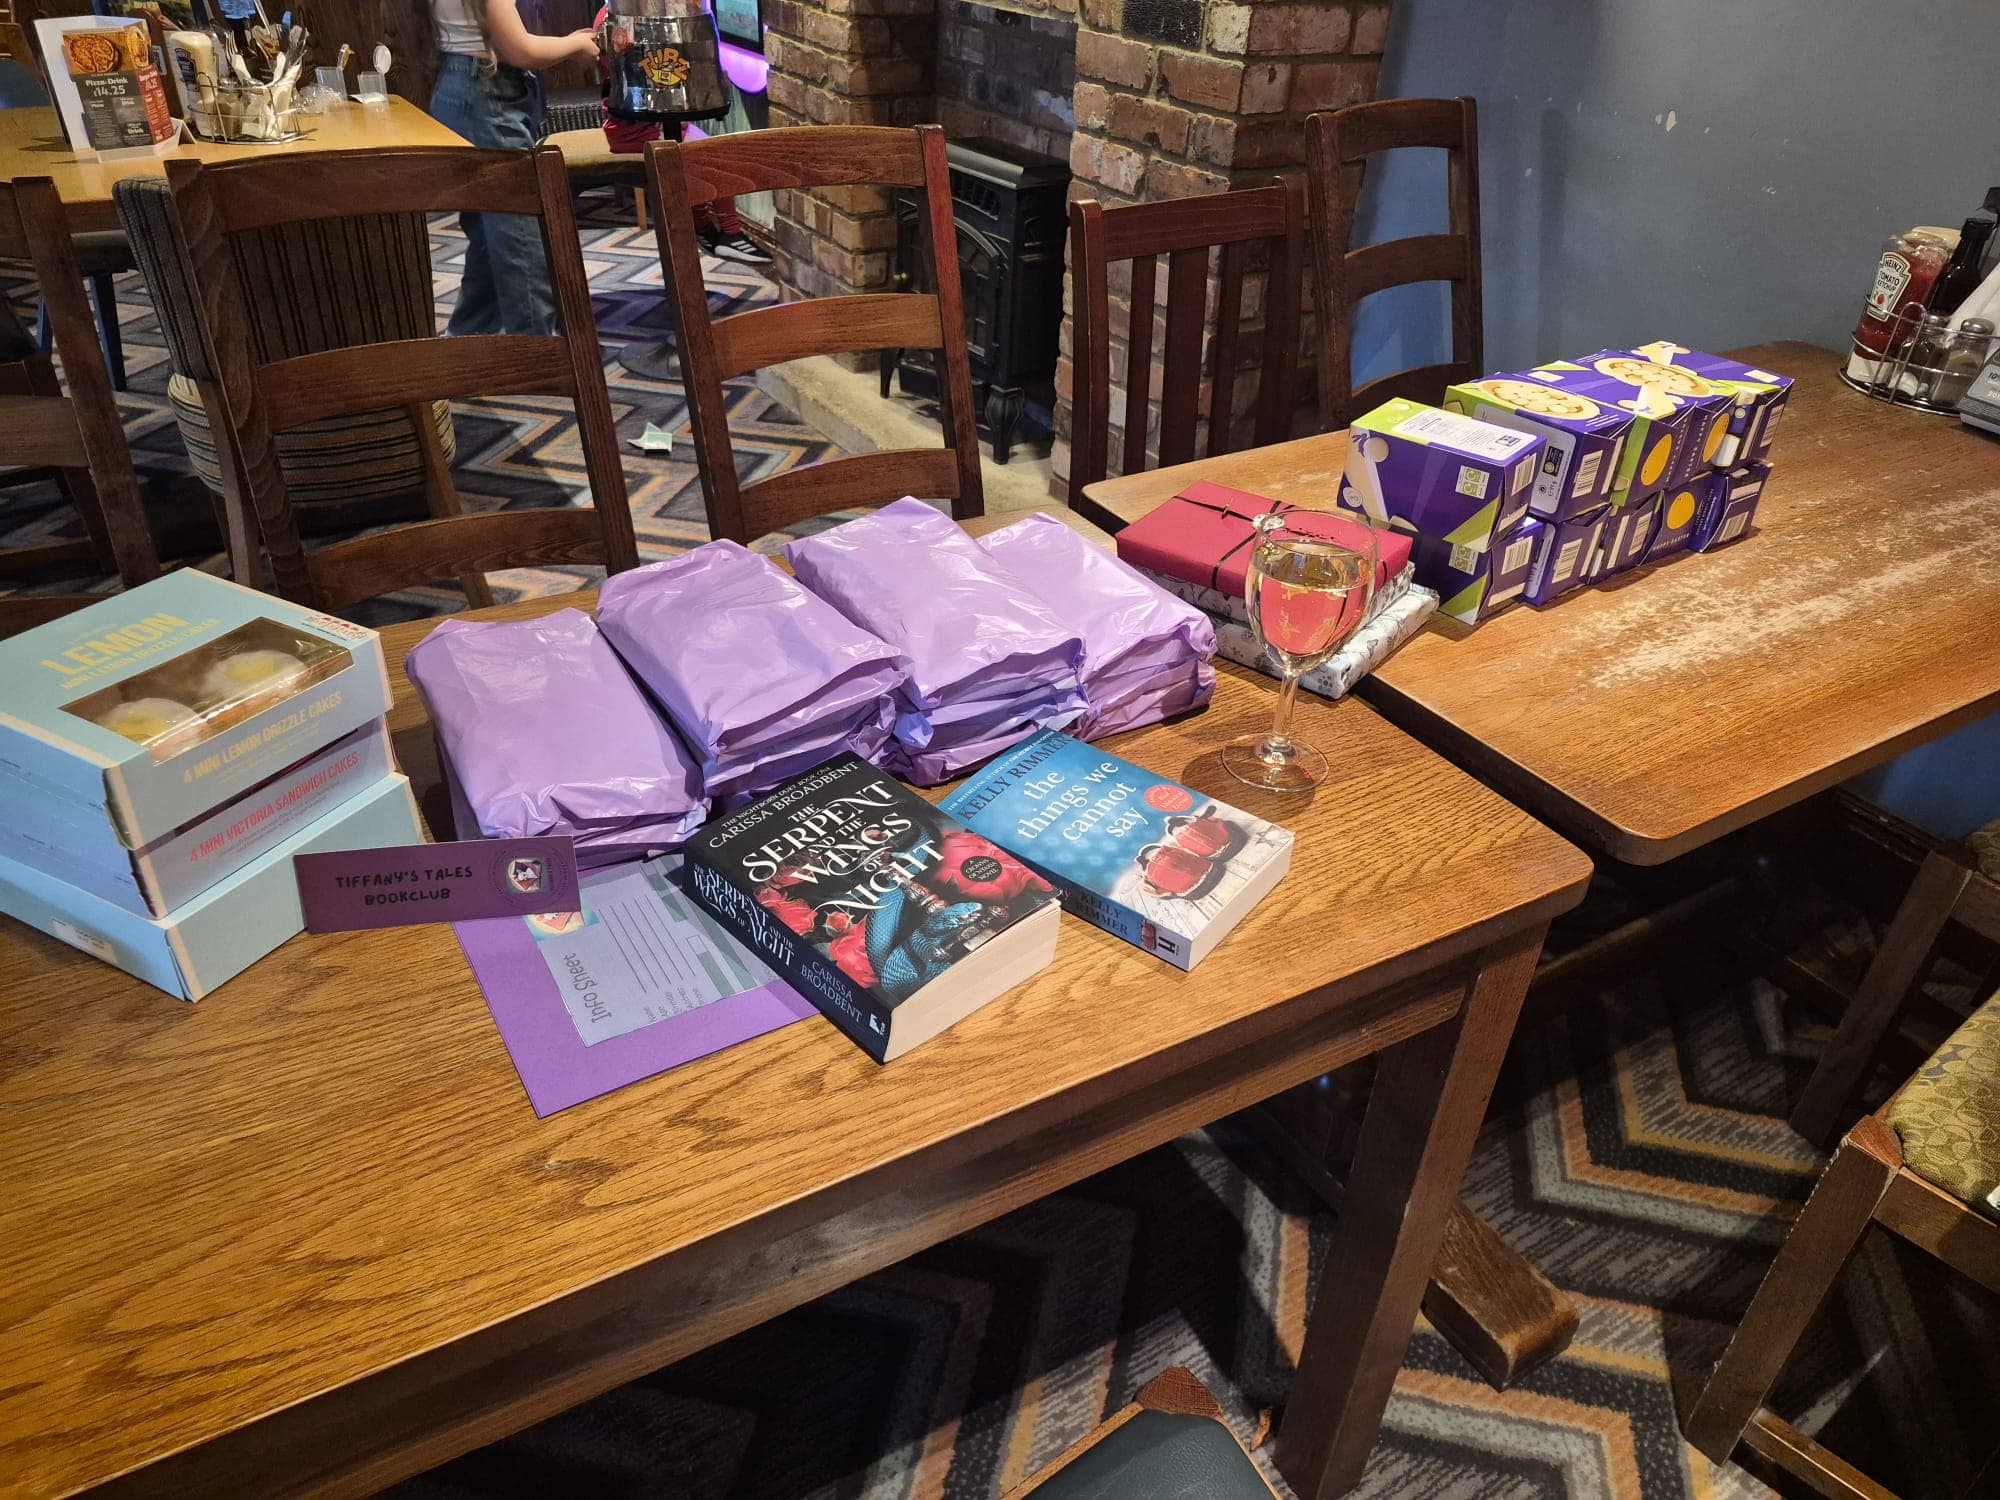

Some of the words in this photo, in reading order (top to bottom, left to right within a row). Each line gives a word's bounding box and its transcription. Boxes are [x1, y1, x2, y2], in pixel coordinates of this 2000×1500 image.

[639, 48, 690, 80] TUBZ
[1880, 270, 1899, 286] TOMATO
[41, 612, 190, 675] LEMON
[184, 768, 192, 784] 4
[194, 754, 222, 778] MINI
[222, 734, 262, 764] LEMON
[262, 709, 306, 742] DRIZZLE
[308, 690, 344, 719] CAKES
[722, 818, 737, 829] THE
[778, 784, 797, 796] DUET
[816, 766, 831, 777] ONE
[958, 776, 1012, 821] KELLY
[1007, 734, 1074, 780] RIMMER
[1017, 784, 1089, 840] things
[1084, 761, 1119, 785] we
[1024, 770, 1065, 800] the
[190, 848, 198, 862] 4
[200, 832, 225, 857] MINI
[226, 804, 275, 842] VICTORIA
[275, 772, 327, 811] SANDWICH
[328, 751, 360, 780] CAKES
[709, 810, 773, 848] CARISSA
[772, 762, 860, 811] BROADBENT
[788, 804, 820, 823] THE
[1062, 782, 1137, 840] cannot
[1106, 807, 1148, 838] say
[742, 780, 900, 882] SERPENT
[790, 812, 912, 884] WINGS
[808, 836, 836, 853] AND
[836, 818, 867, 838] THE
[336, 871, 418, 889] TIFFANY'S
[424, 866, 473, 882] TALES
[813, 840, 944, 920] NIGHT
[864, 856, 884, 872] OF
[364, 888, 451, 906] BOOKCLUB
[694, 871, 737, 919] WINGS
[748, 912, 795, 966] NIGHT
[706, 867, 769, 927] SERPENT
[1076, 902, 1128, 934] RIMMER
[1082, 892, 1121, 919] KELLY
[563, 953, 597, 991] Sheet
[801, 965, 862, 1022] BROADBENT
[812, 961, 852, 1002] CARISSA
[583, 992, 612, 1023] Info
